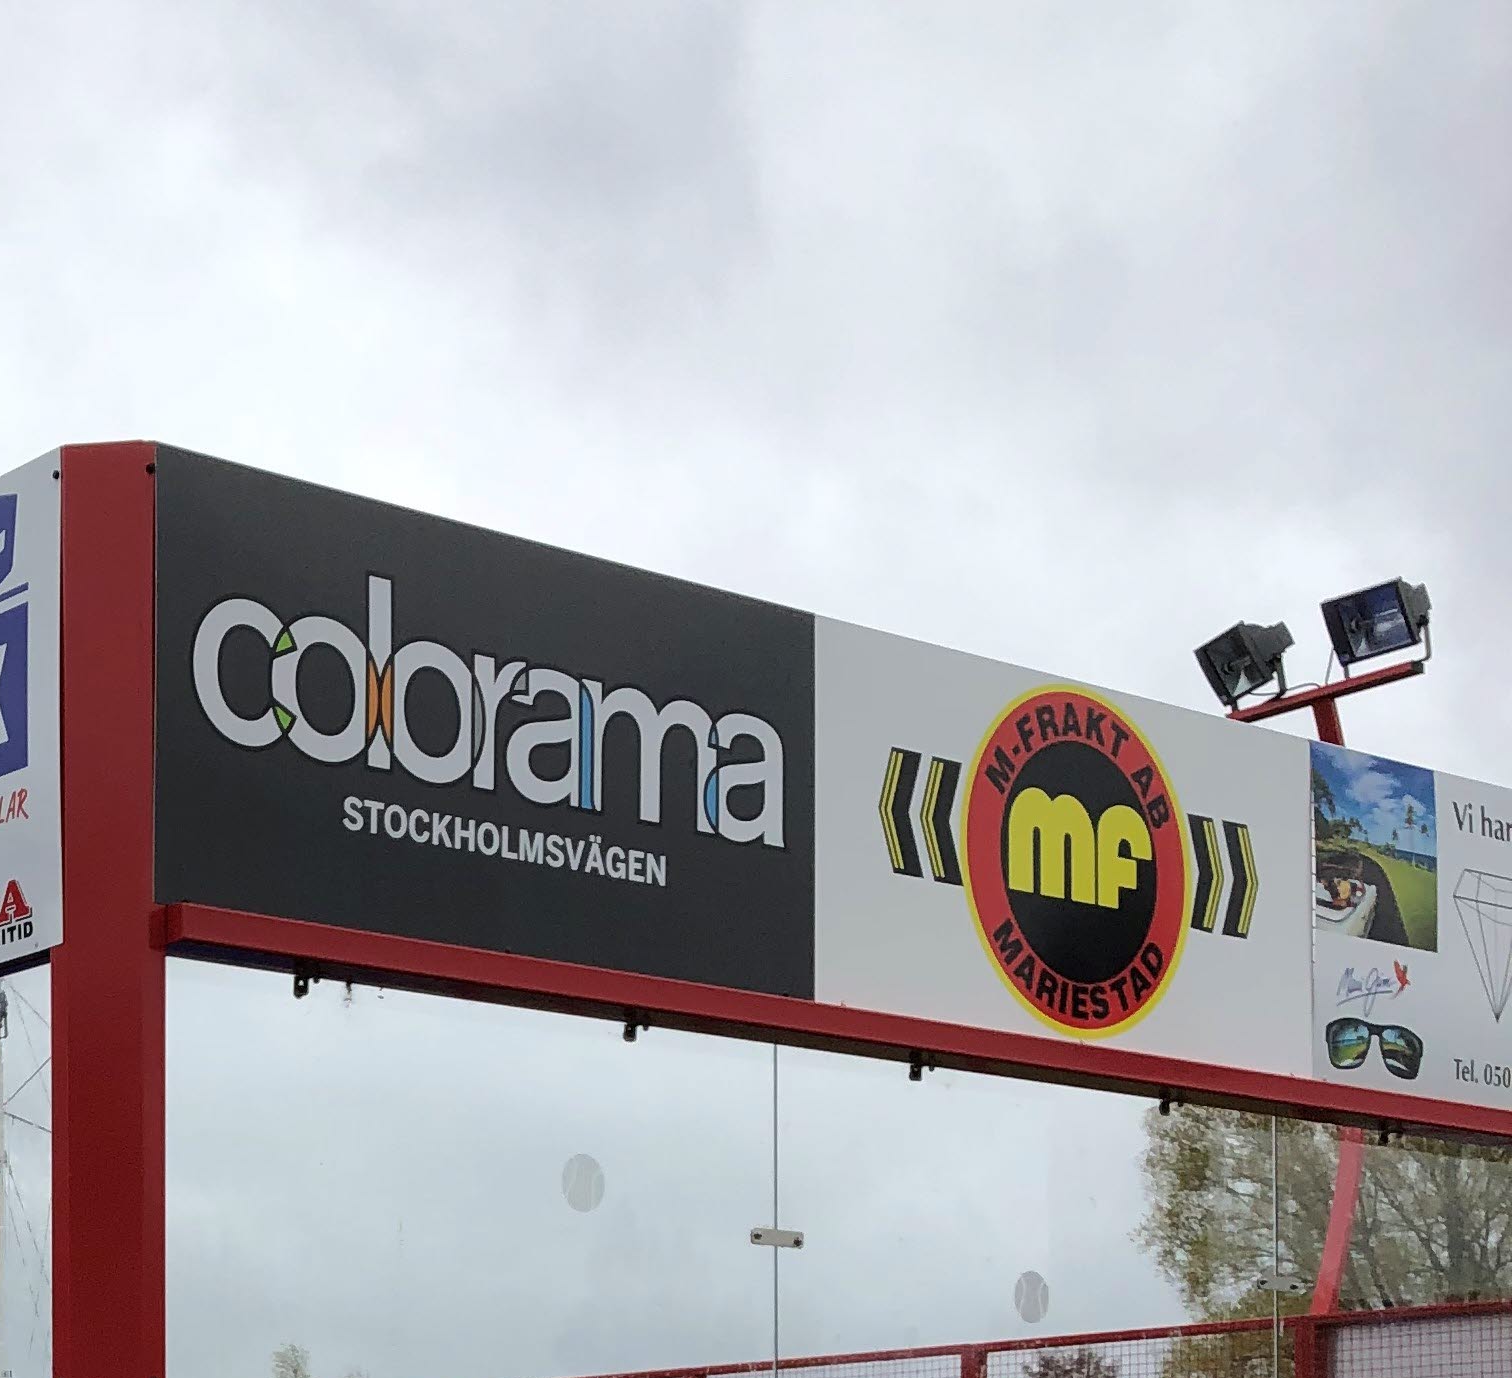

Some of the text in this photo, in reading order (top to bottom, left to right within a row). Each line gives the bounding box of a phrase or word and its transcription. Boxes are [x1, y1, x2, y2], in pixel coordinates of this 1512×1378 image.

[192, 574, 786, 849] colorama
[984, 702, 1170, 831] M-FRAKT AB
[342, 795, 667, 887] STOCKHOLMSVÄGEN
[1451, 801, 1474, 834] Vi
[992, 917, 1165, 1021] MARIESTAD
[1453, 1058, 1479, 1084] Tel.
